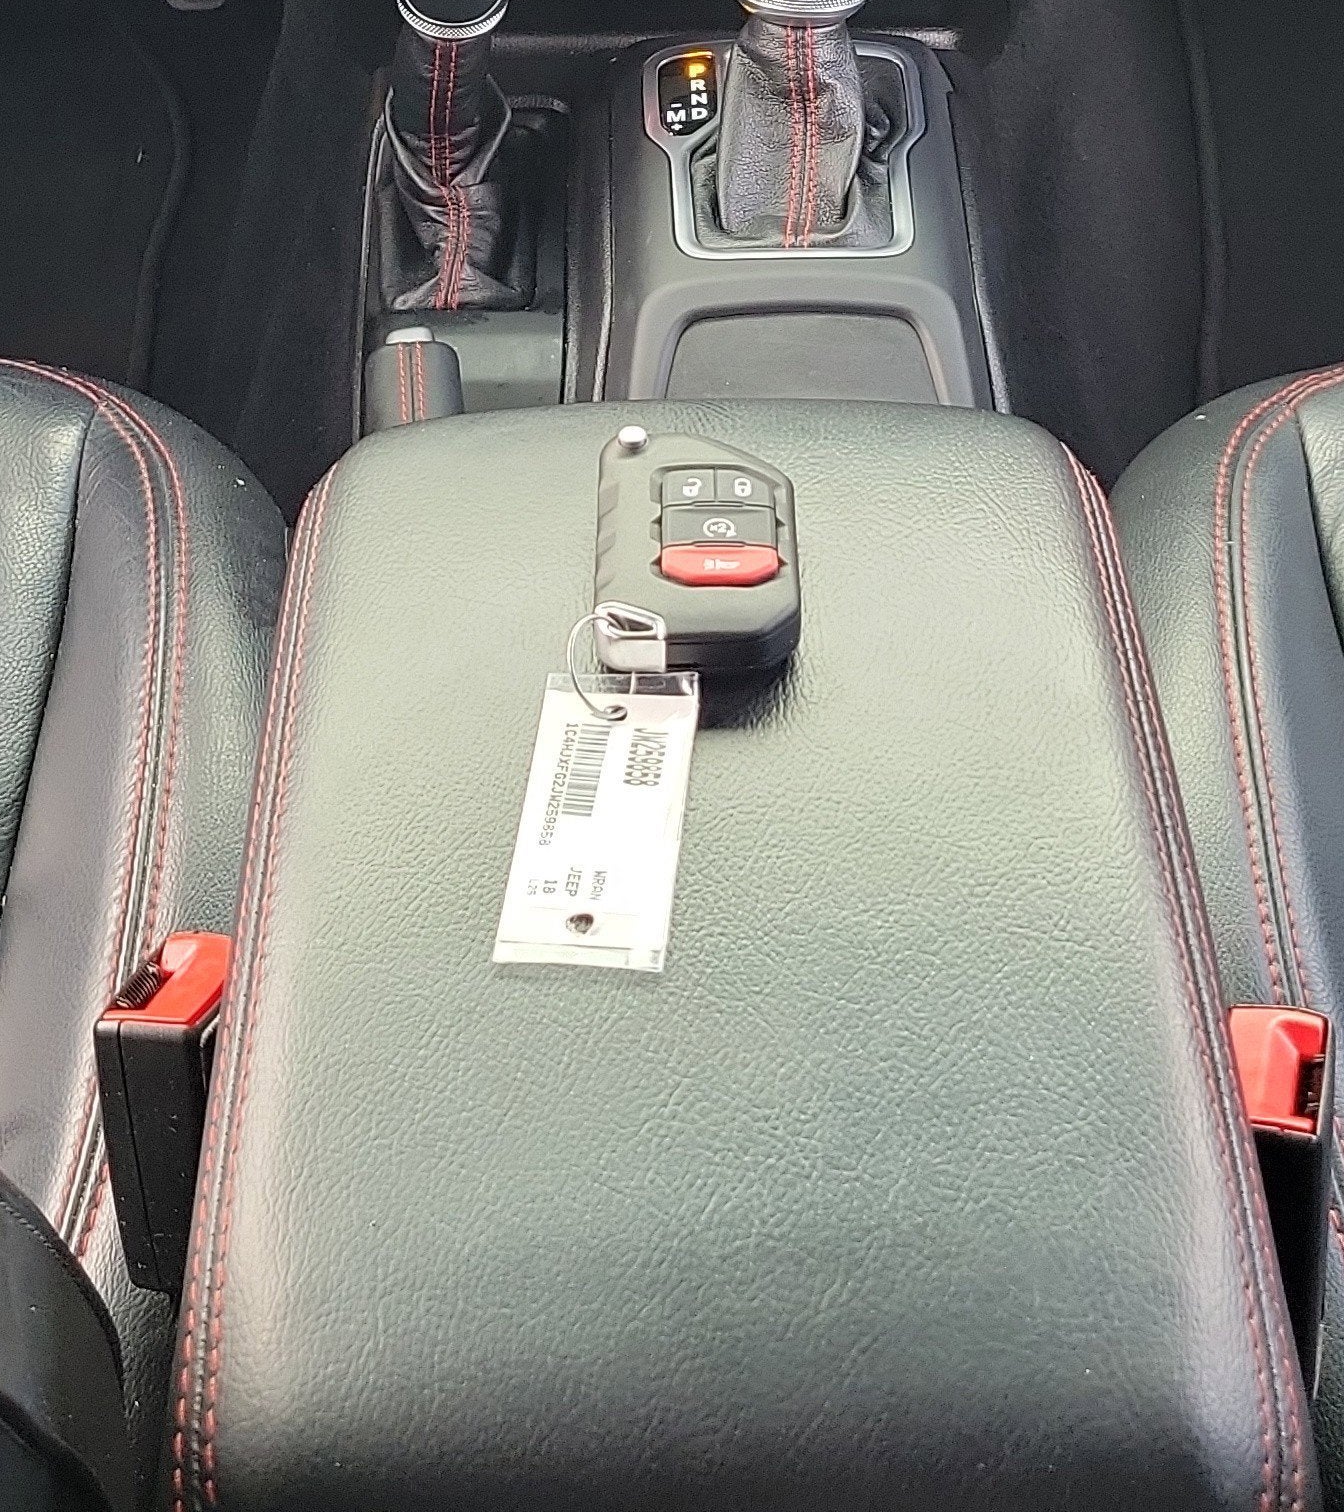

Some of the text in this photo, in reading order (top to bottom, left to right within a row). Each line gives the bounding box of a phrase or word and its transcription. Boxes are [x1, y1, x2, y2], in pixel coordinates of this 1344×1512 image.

[688, 64, 707, 78] P
[690, 79, 707, 91] R
[691, 92, 708, 105] N
[666, 109, 686, 123] M
[691, 107, 708, 120] D
[622, 727, 670, 788] JW259858
[542, 879, 558, 895] 18
[565, 866, 584, 898] JEEP
[589, 870, 608, 902] WRAN
